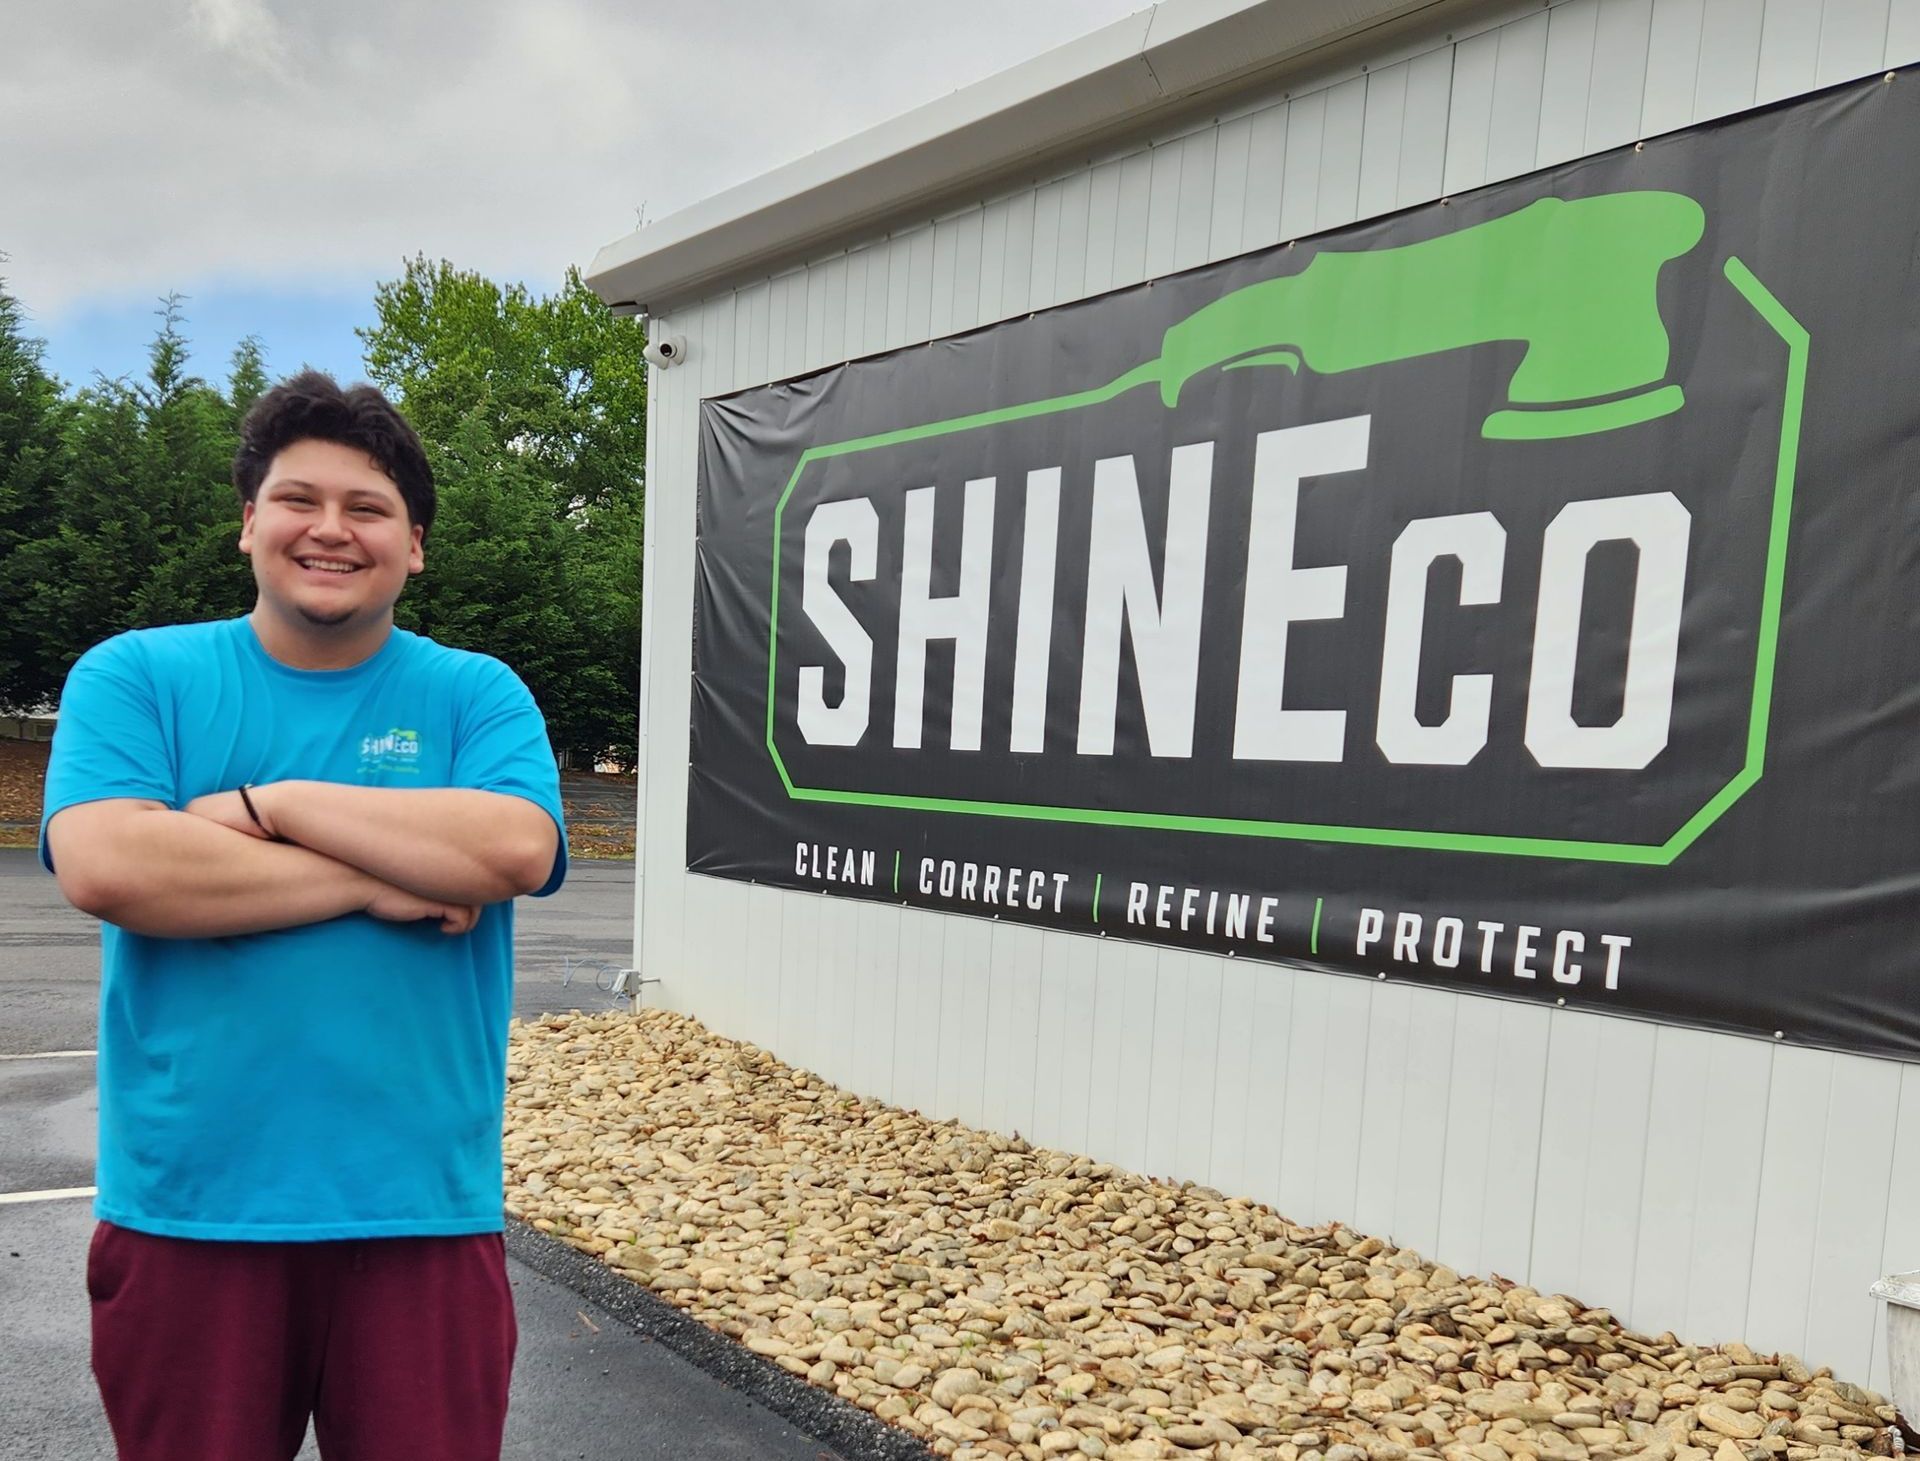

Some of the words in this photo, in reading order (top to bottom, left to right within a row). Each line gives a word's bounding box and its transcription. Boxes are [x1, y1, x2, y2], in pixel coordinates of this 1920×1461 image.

[795, 842, 875, 886] CLEAN
[919, 857, 1069, 913] CORRECT
[1127, 881, 1279, 943] REFINE
[1356, 908, 1633, 990] PROTECT
